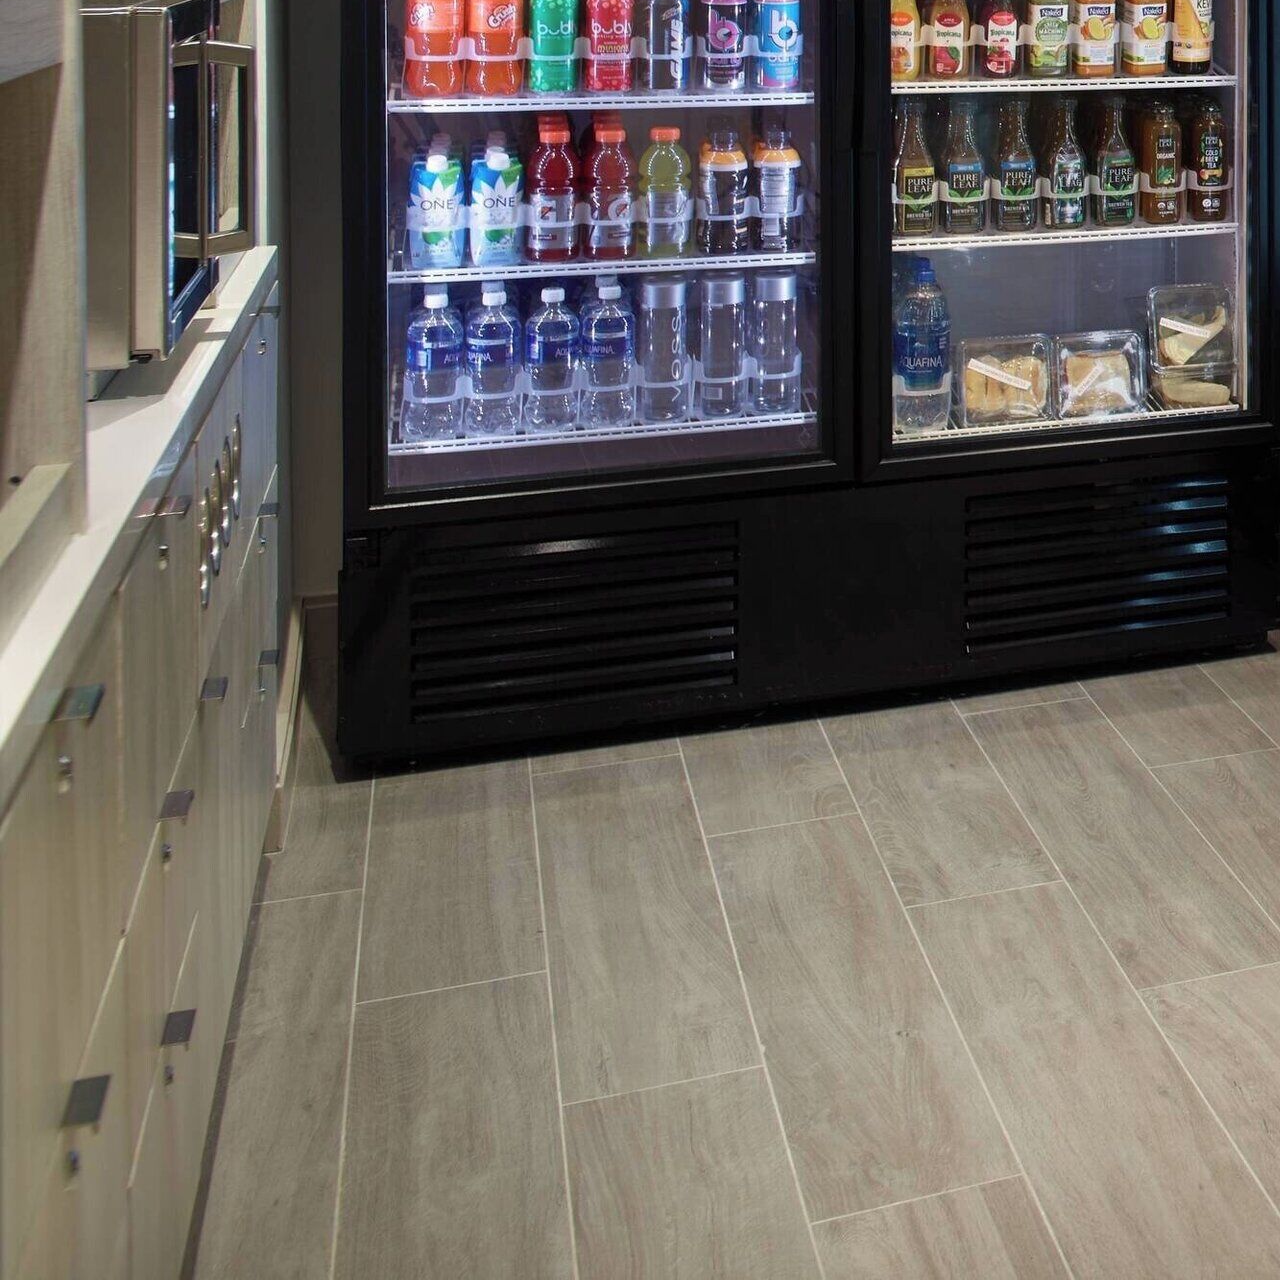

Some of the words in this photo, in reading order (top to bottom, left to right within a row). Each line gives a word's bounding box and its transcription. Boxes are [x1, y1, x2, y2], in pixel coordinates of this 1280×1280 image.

[1042, 8, 1062, 16] Naked
[1144, 7, 1163, 15] Naked
[591, 20, 633, 37] bubly
[936, 30, 961, 38] Tropicana
[990, 29, 1015, 37] Tropicana
[1109, 168, 1131, 176] PURE
[1005, 178, 1031, 186] LEAF
[1109, 175, 1131, 183] LEAF
[907, 185, 932, 193] LEAF
[953, 181, 977, 189] LEAF
[671, 316, 682, 402] VOSS
